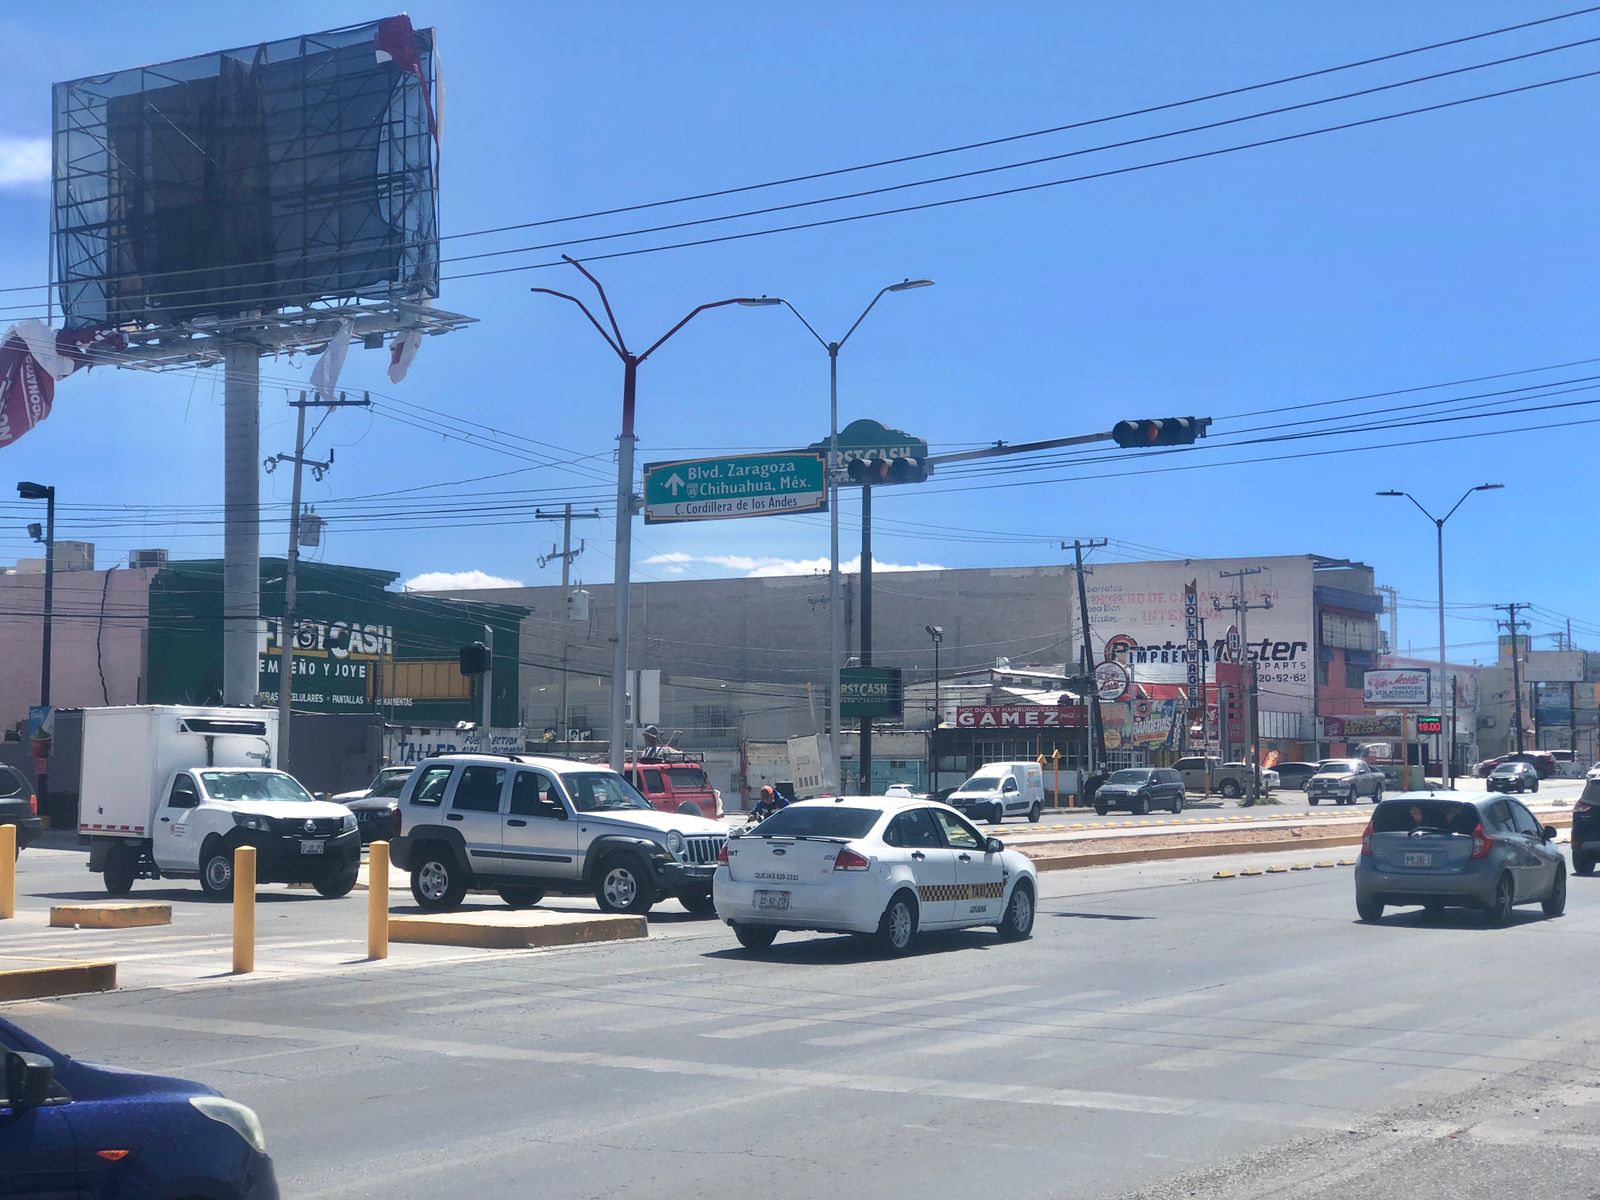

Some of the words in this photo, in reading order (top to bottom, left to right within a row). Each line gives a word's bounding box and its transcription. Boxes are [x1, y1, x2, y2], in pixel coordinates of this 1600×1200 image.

[688, 466, 723, 480] Blvd.
[727, 462, 795, 479] Zaragoza
[780, 476, 812, 490] Méx.
[675, 503, 684, 515] C.
[687, 499, 733, 514] Cordillera
[737, 498, 748, 510] de
[752, 497, 765, 509] los
[768, 496, 798, 508] Andes
[1128, 650, 1210, 664] IMPRENA
[258, 658, 316, 675] EMEÑO
[323, 663, 330, 676] Y
[335, 664, 366, 678] JOYE
[841, 683, 887, 696] RSTCASH
[332, 695, 364, 705] PANTALLAS
[959, 712, 1059, 725] GAMEZ
[1417, 722, 1441, 732] 19.00
[491, 735, 518, 745] ECTION
[755, 872, 776, 880] QUEJAS
[971, 883, 986, 898] TAXI
